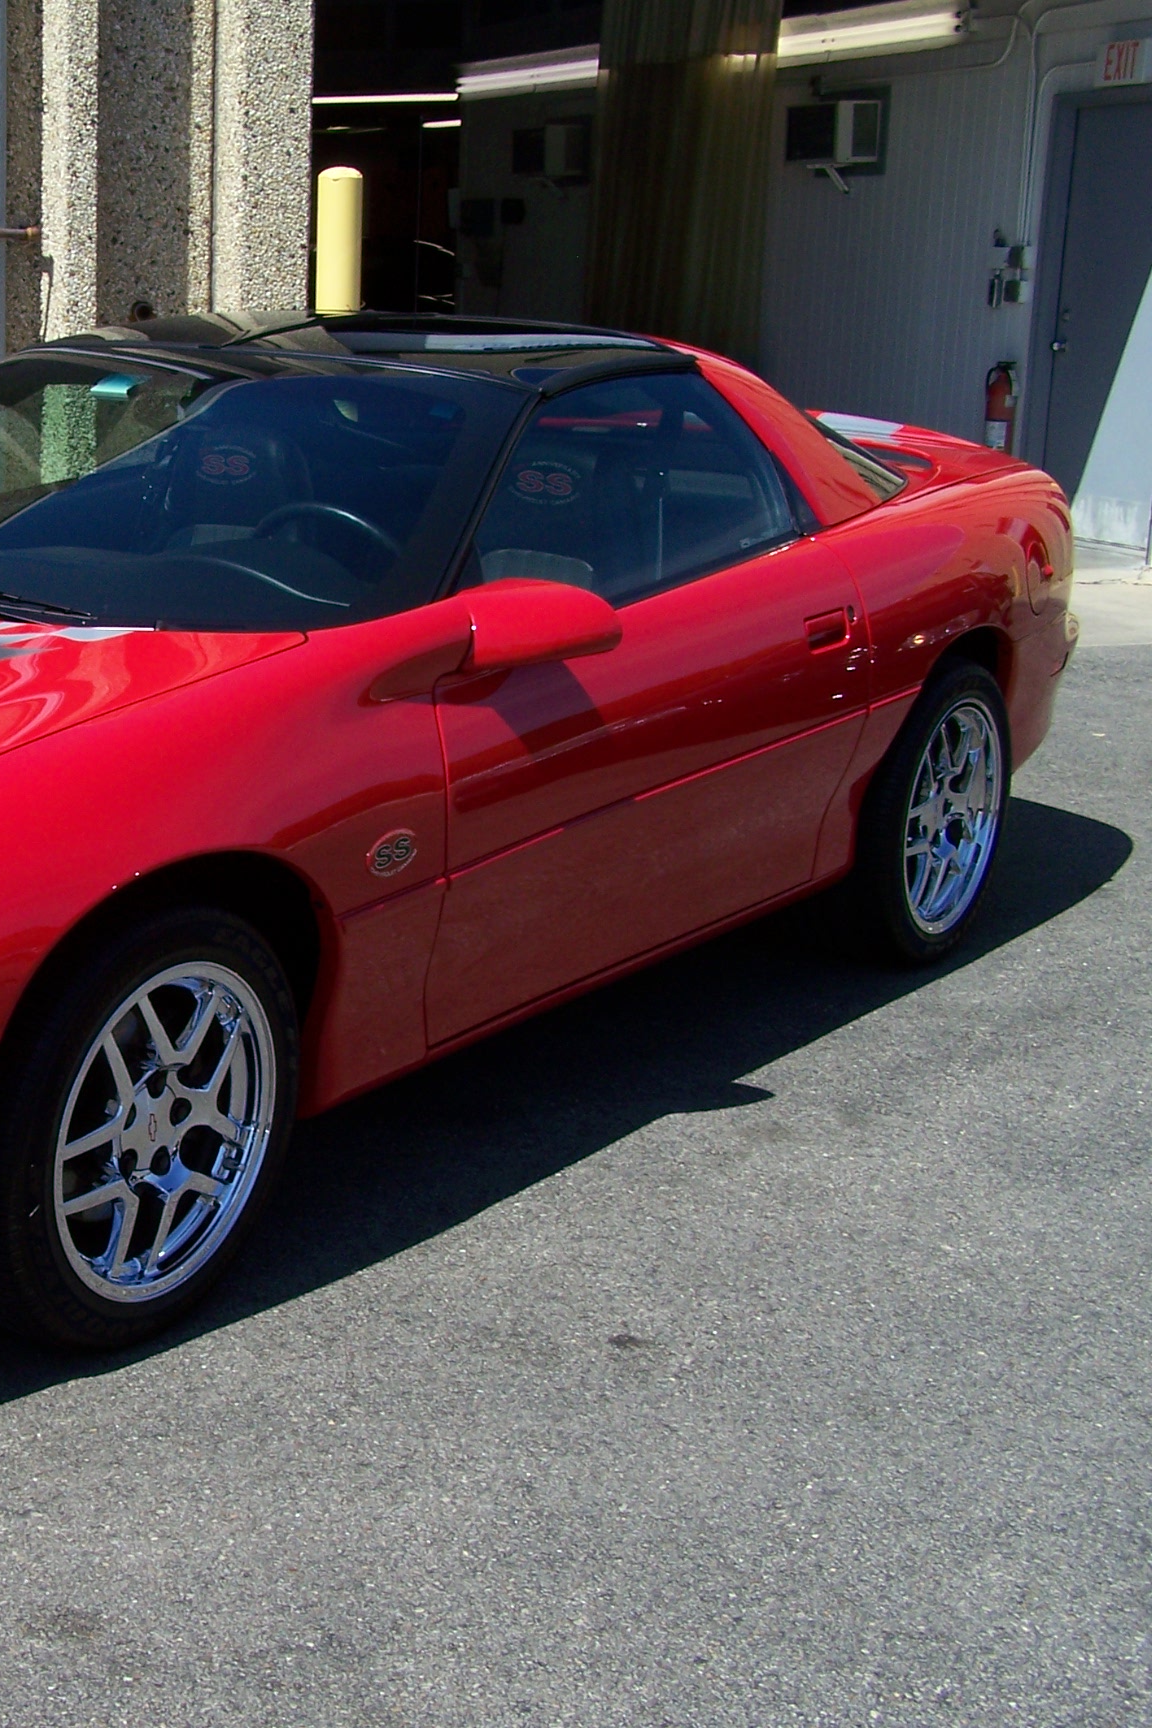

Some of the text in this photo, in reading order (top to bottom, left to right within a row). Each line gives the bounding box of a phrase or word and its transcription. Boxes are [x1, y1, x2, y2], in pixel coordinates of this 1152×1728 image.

[1103, 41, 1140, 81] EXIT
[201, 454, 250, 476] SS
[516, 468, 573, 496] SS
[374, 836, 412, 870] SS
